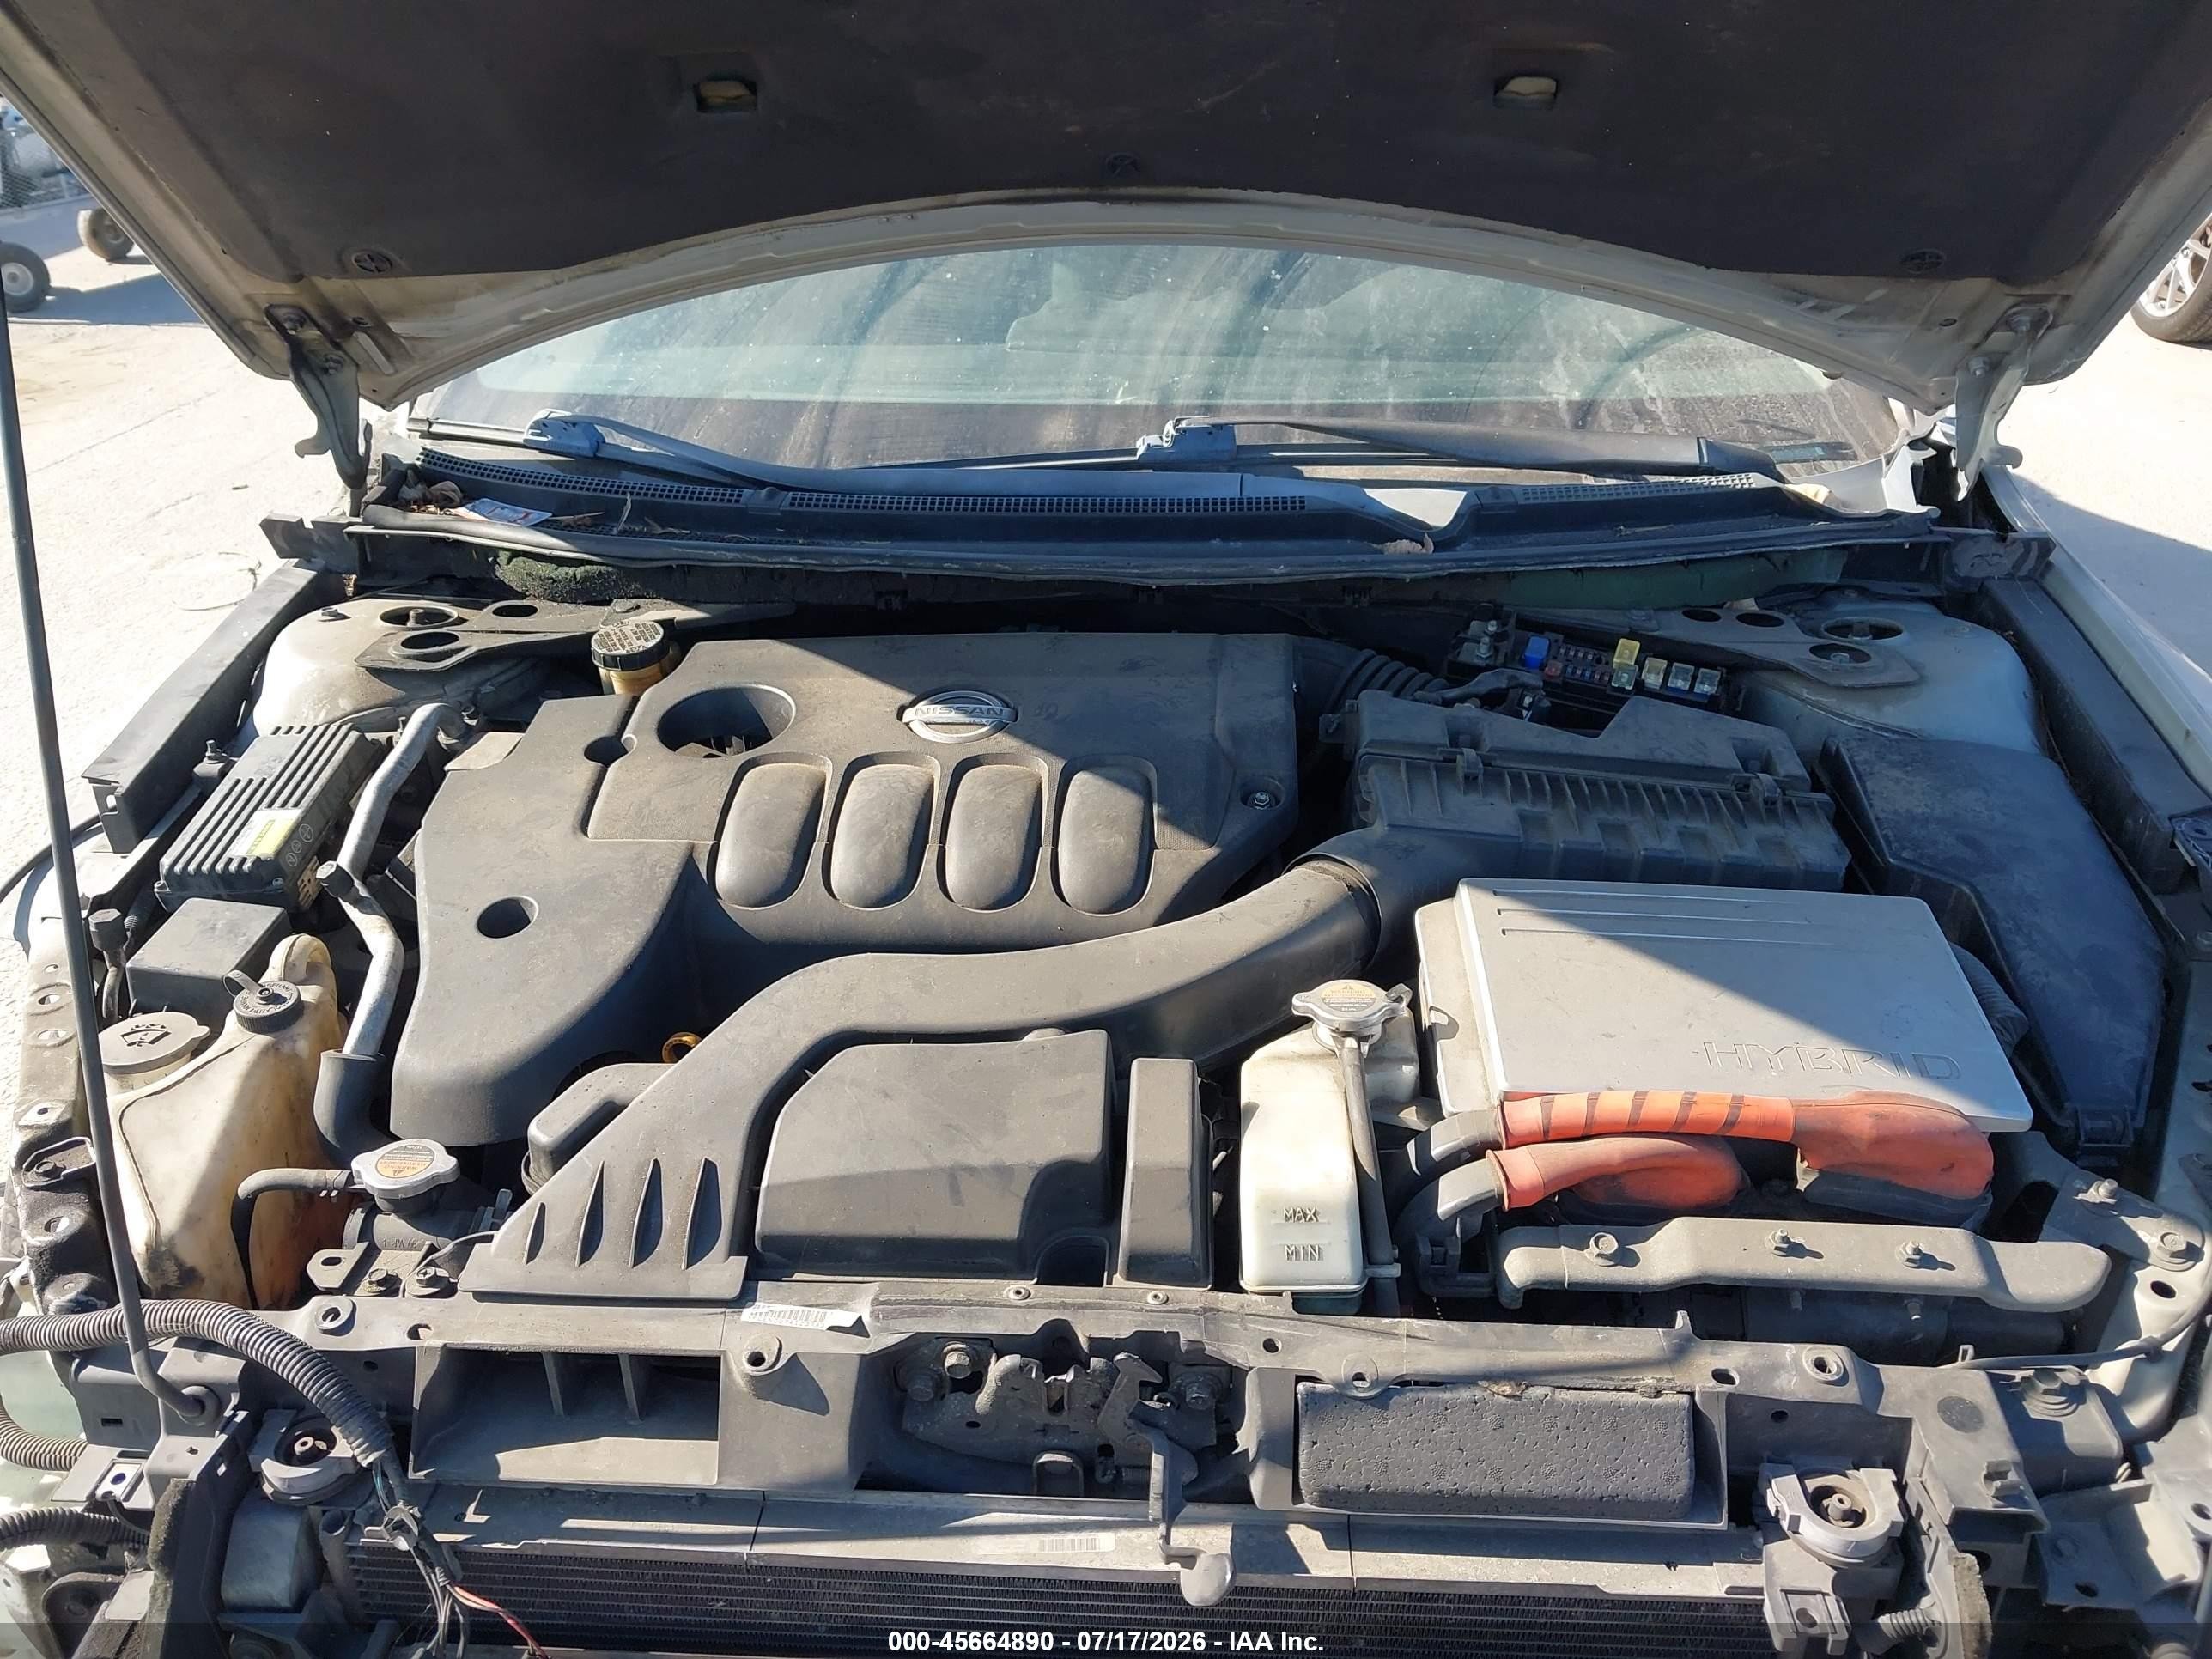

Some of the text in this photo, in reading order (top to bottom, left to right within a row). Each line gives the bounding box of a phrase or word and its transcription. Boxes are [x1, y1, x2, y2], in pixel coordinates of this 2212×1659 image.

[914, 705, 1004, 716] NISSAN
[1703, 1041, 1962, 1080] HYBRID
[1283, 1206, 1320, 1223] MAX
[1285, 1244, 1323, 1261] MIN
